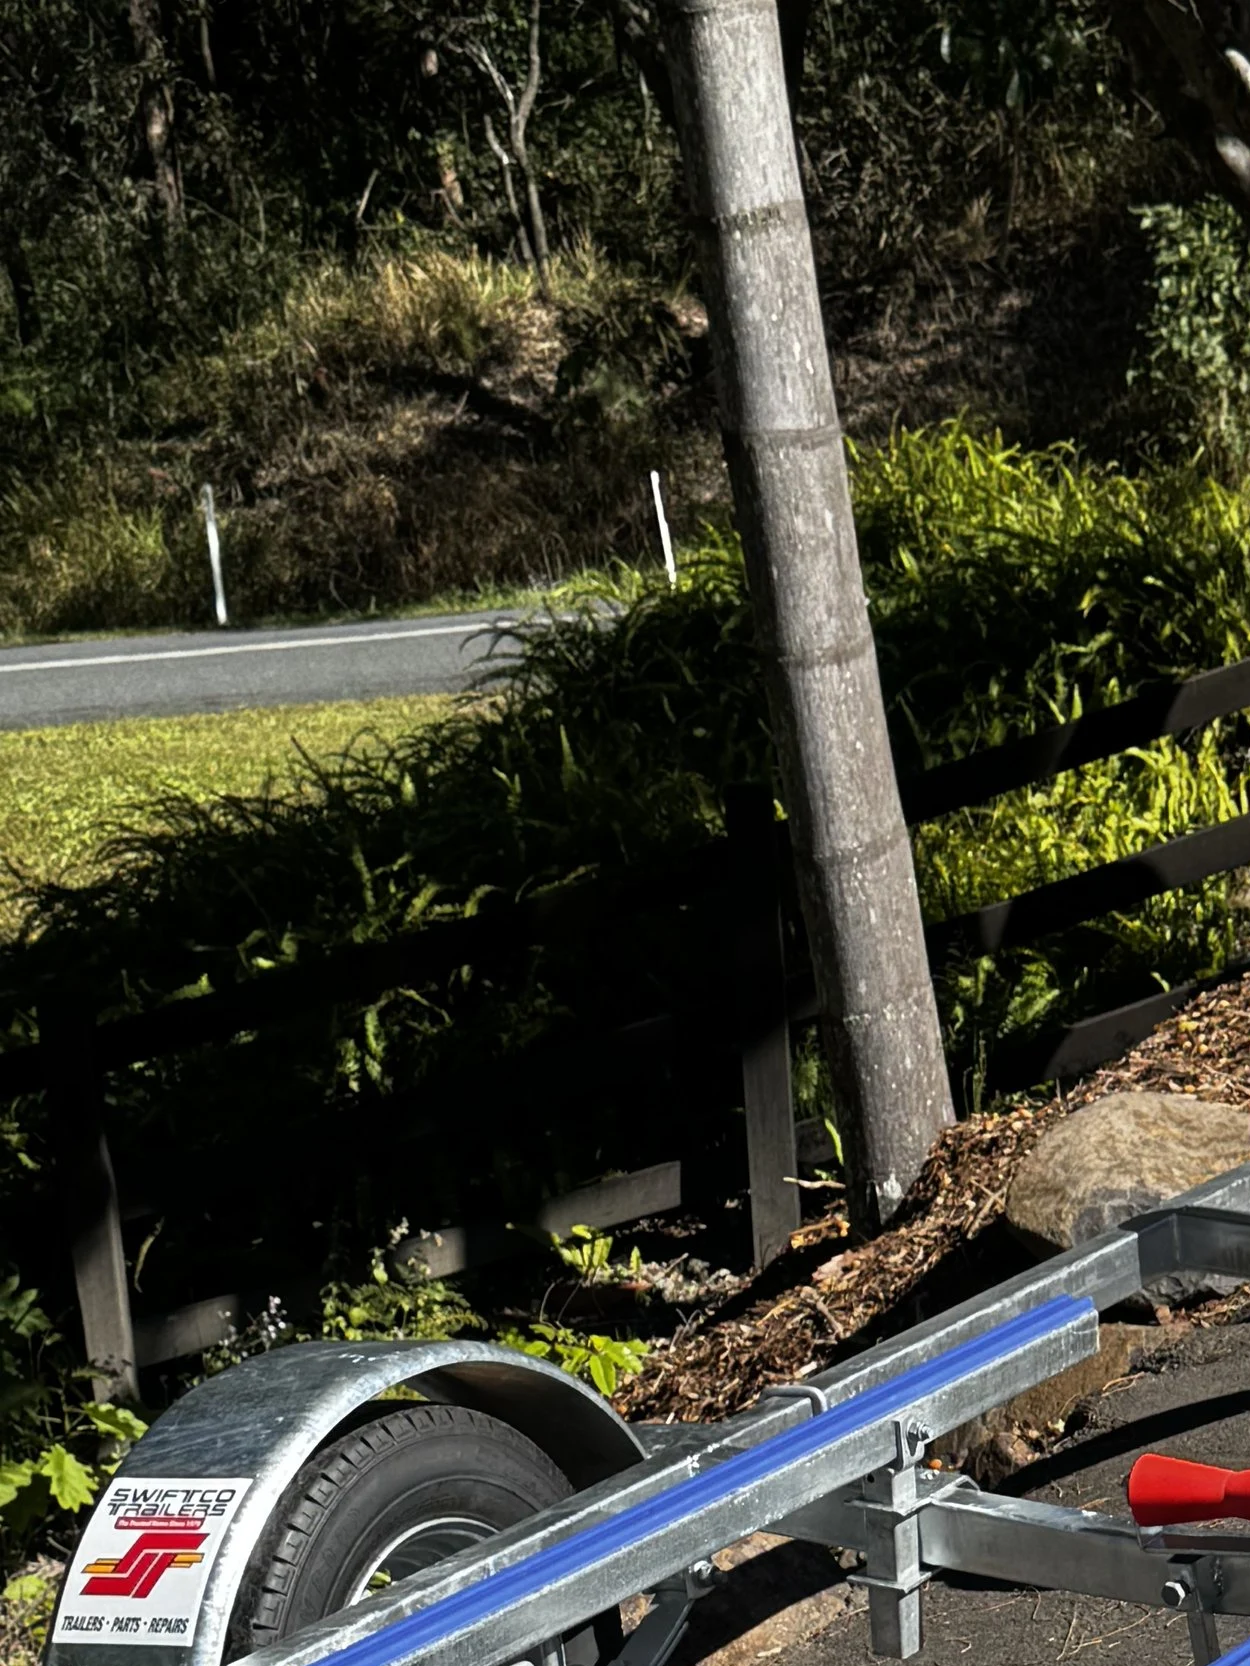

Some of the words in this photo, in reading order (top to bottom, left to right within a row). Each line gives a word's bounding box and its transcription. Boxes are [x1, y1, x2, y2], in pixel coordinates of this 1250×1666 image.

[110, 1488, 236, 1504] SWIFTCO
[107, 1502, 228, 1517] TRAILERS
[61, 1615, 105, 1632] TRAILERS
[110, 1616, 142, 1633] PARTS
[147, 1617, 190, 1634] REPAIRS
